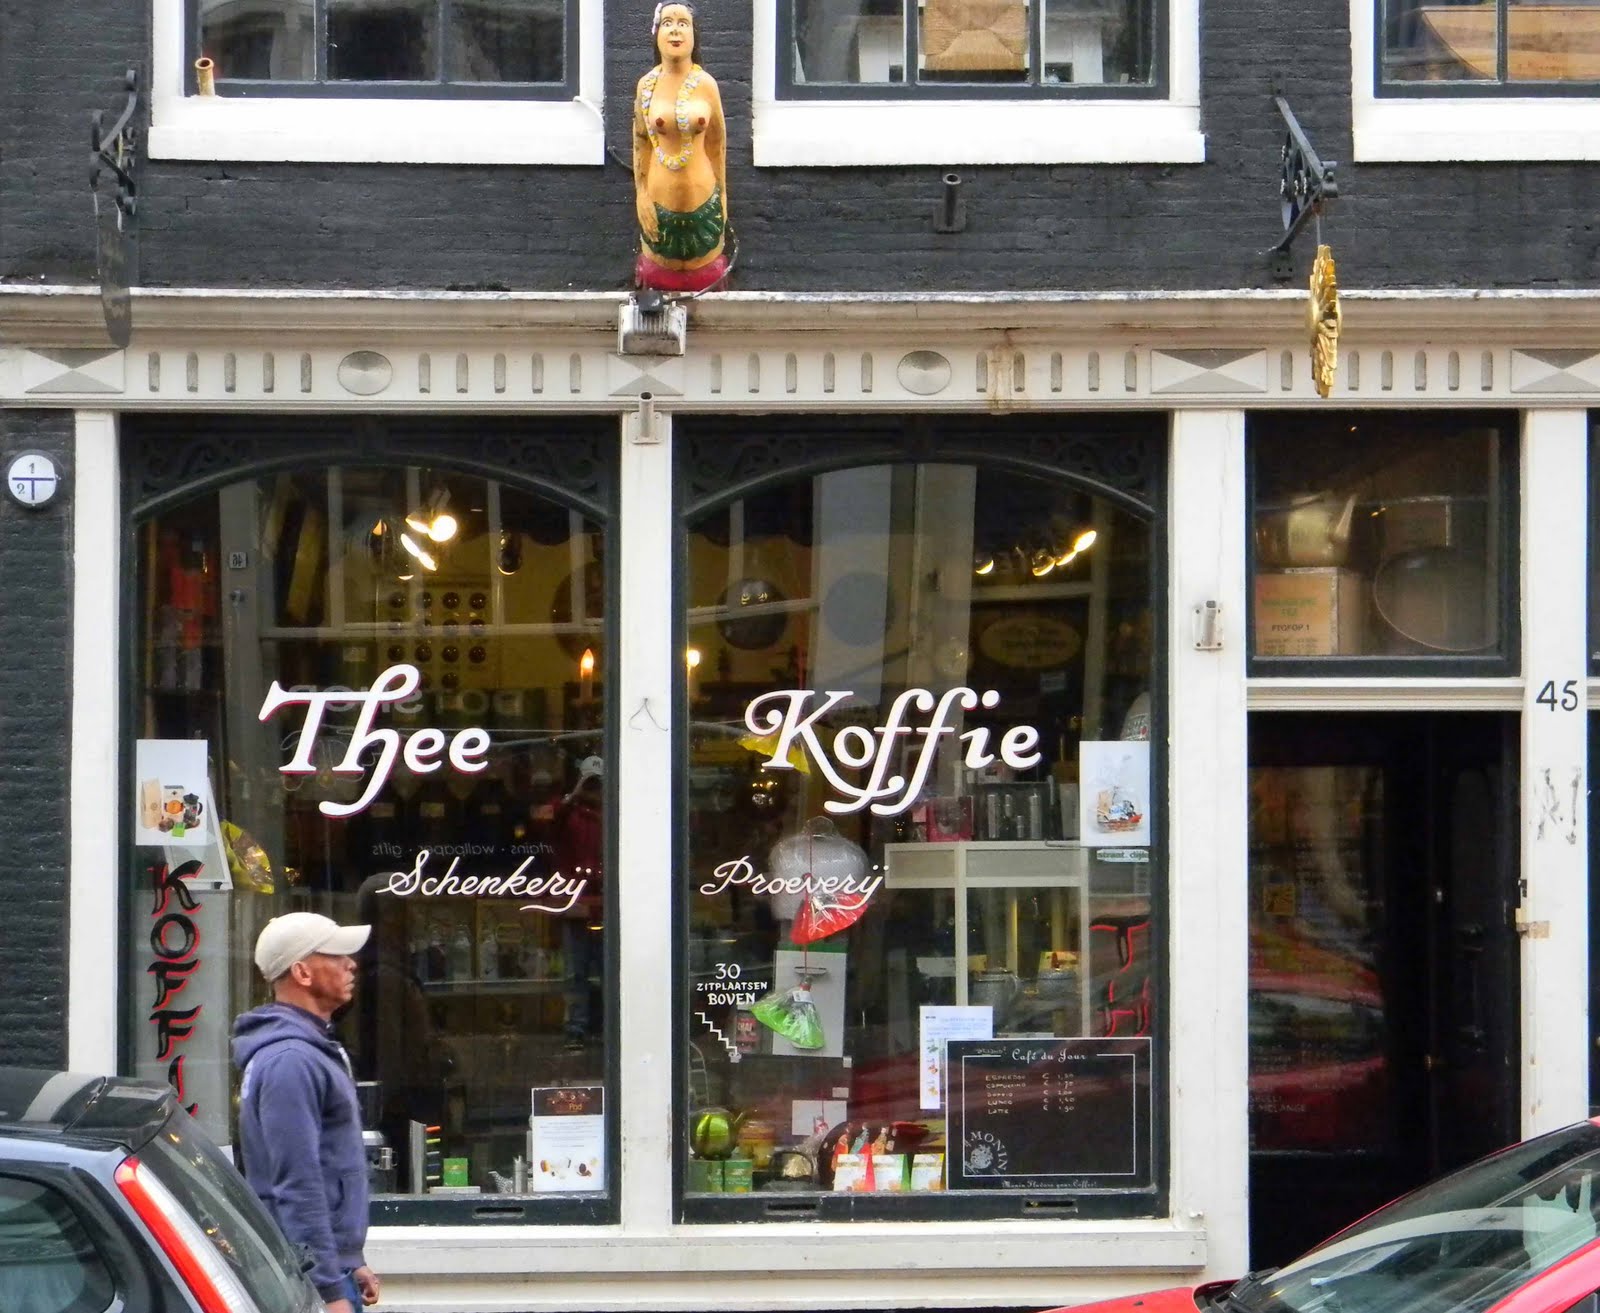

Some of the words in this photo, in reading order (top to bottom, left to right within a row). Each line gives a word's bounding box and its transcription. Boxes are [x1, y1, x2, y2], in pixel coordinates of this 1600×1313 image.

[29, 463, 35, 474] 1
[16, 483, 26, 494] 2
[1536, 680, 1578, 711] 45
[258, 664, 490, 818] Thee
[744, 687, 1042, 817] Koffie
[375, 850, 592, 913] Schenkerij
[700, 855, 889, 912] Proeverij
[696, 981, 768, 991] ZITPLAATSEN
[715, 963, 741, 979] 30
[147, 859, 205, 1118] KOFFI
[707, 992, 756, 1005] BOVEN
[1011, 1048, 1037, 1064] Café
[1040, 1050, 1054, 1060] du
[1058, 1048, 1087, 1063] Jour
[970, 1130, 1008, 1171] MONIN
